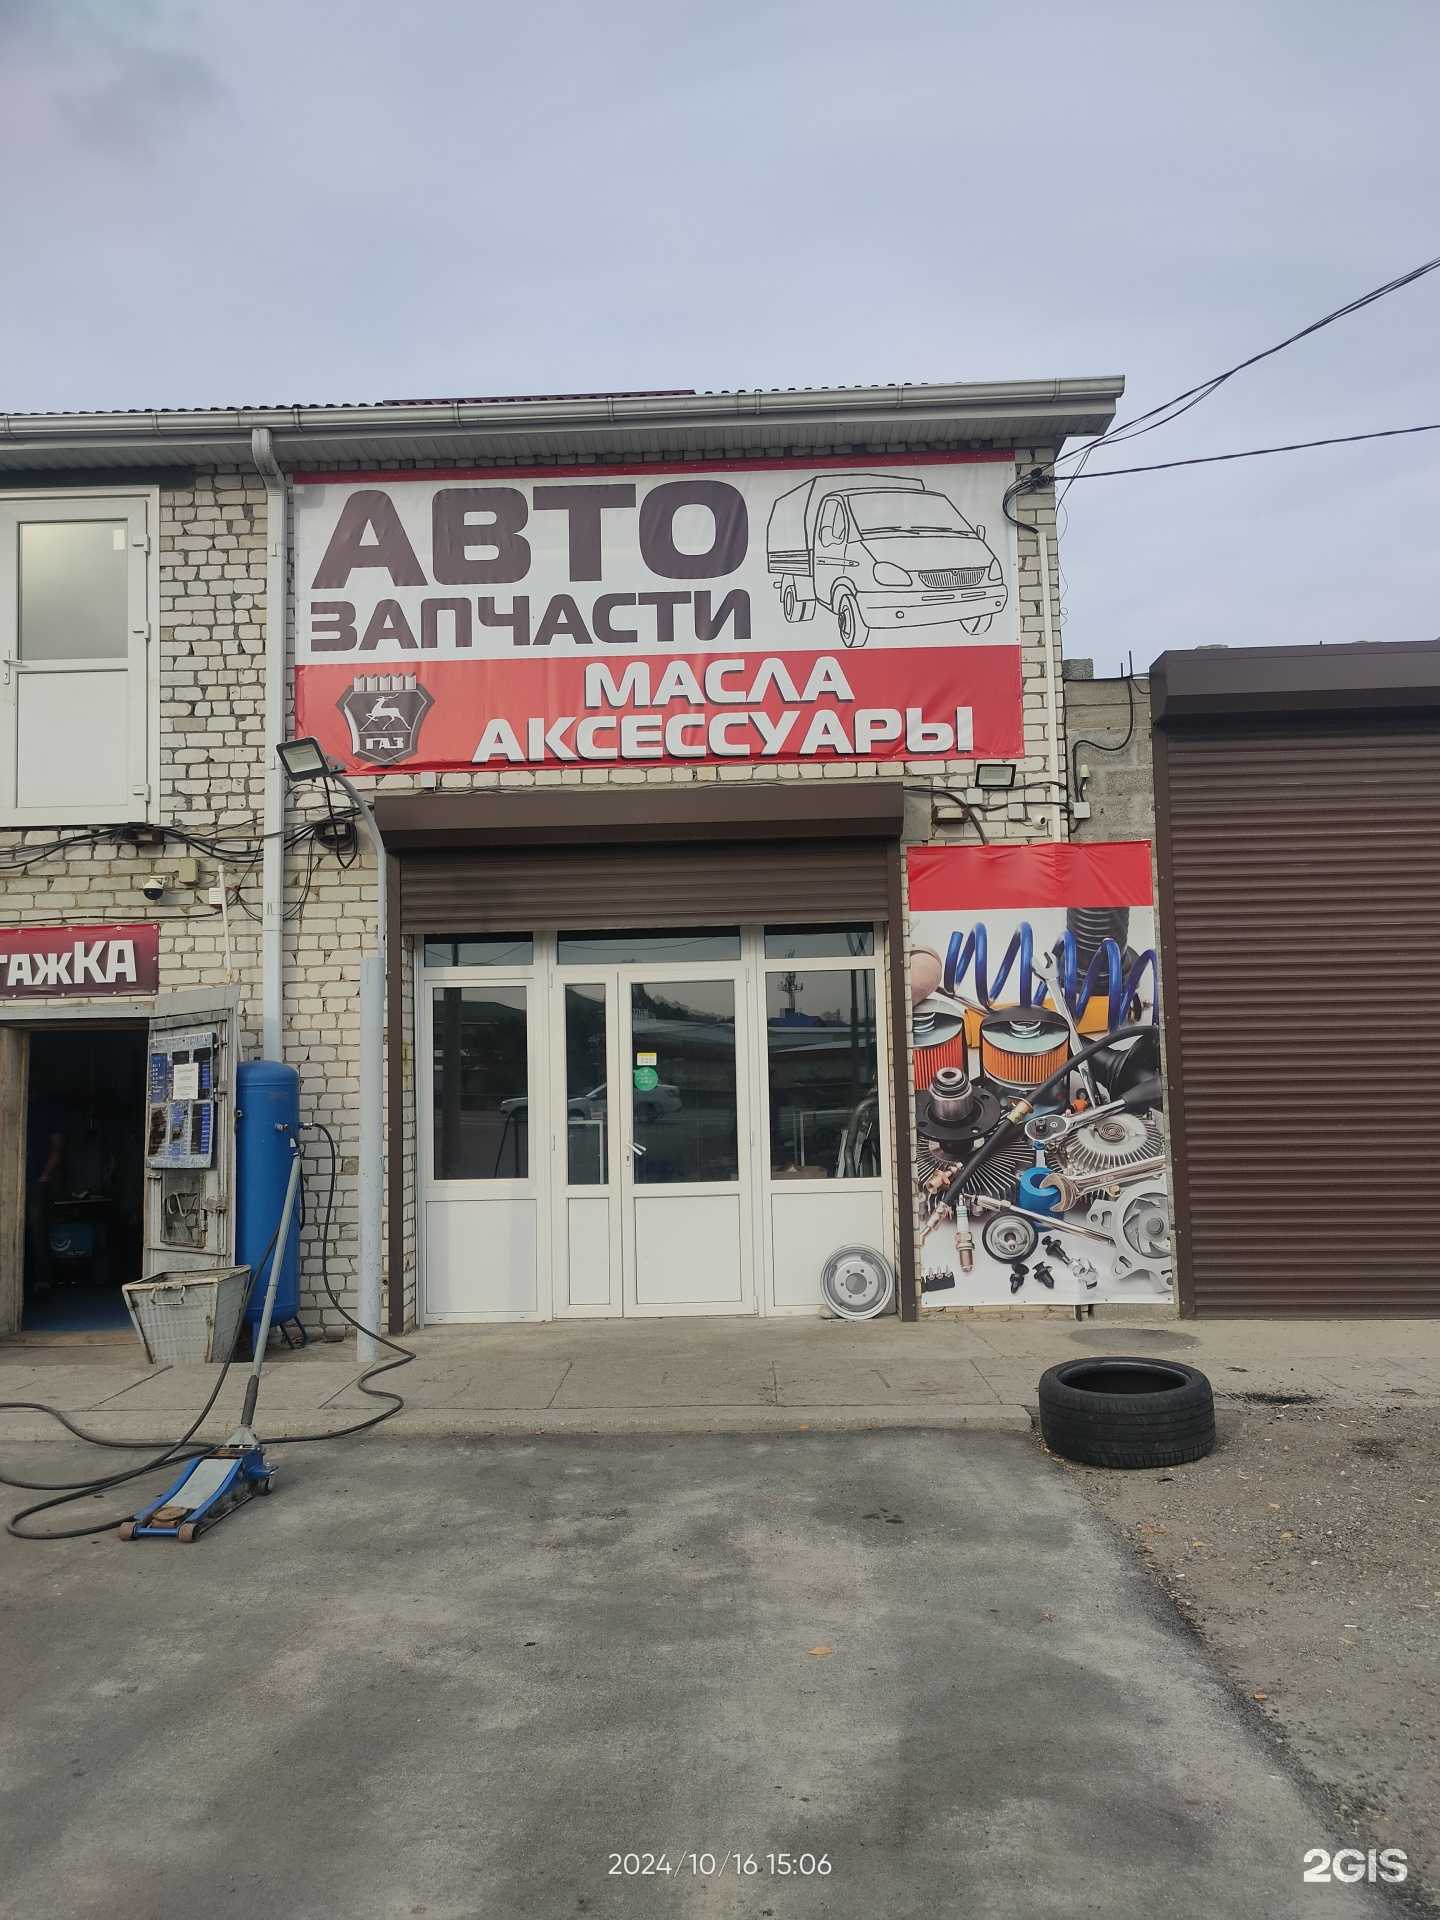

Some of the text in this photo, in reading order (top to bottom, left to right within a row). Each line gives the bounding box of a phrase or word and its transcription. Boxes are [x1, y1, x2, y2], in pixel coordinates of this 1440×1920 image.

[311, 480, 749, 589] АВТО
[310, 589, 752, 652] ЗАПЧАСТИ
[585, 655, 855, 709] МАСЛА
[366, 737, 404, 750] ГАЗ
[471, 705, 974, 763] АКСЕССУАРЫ
